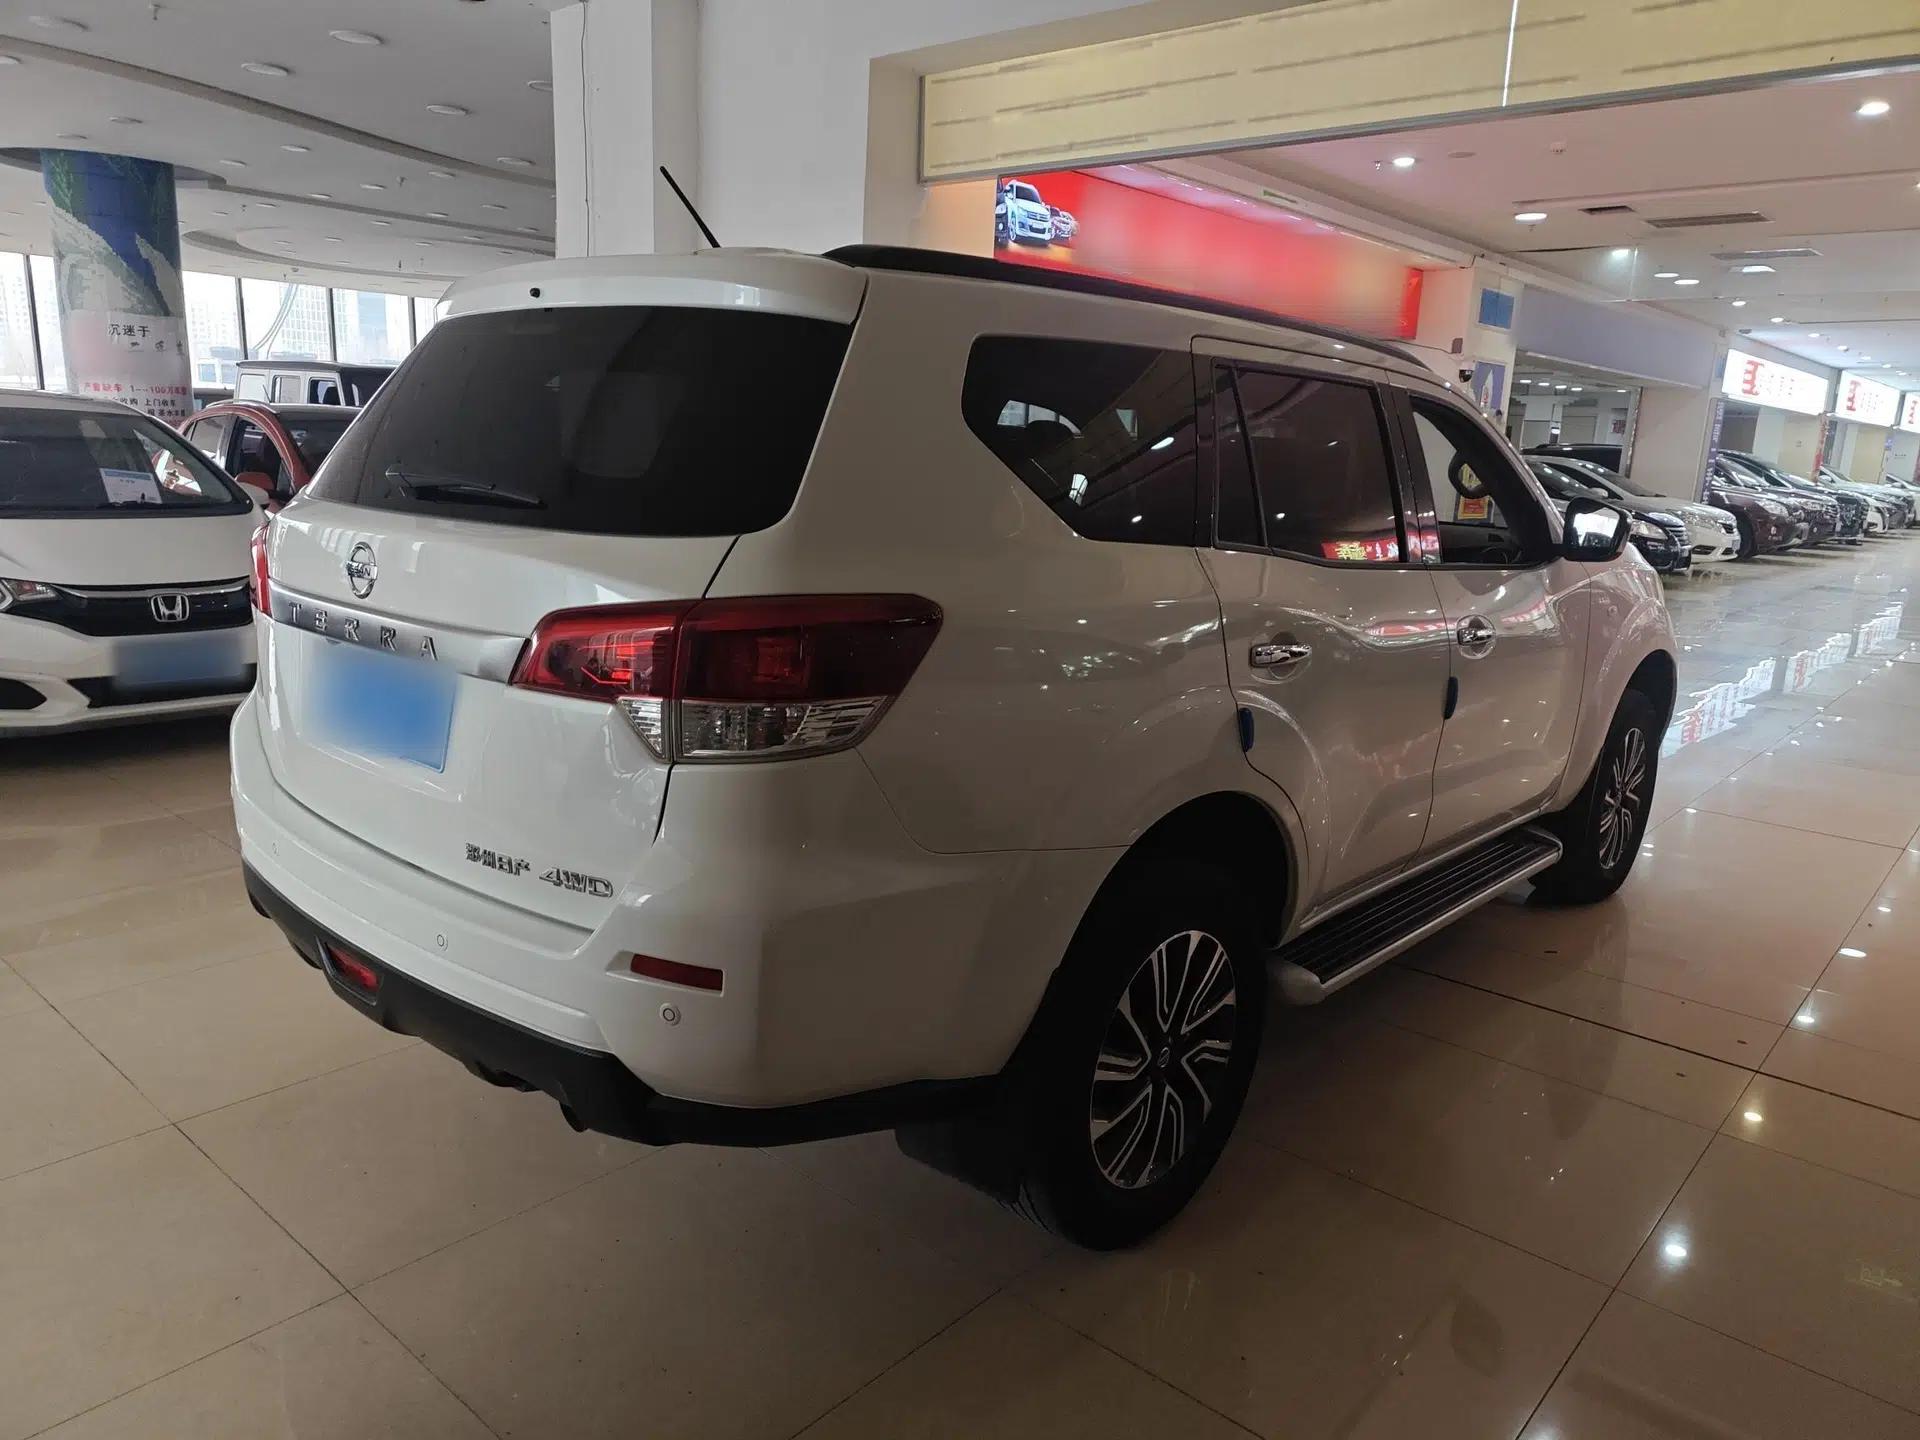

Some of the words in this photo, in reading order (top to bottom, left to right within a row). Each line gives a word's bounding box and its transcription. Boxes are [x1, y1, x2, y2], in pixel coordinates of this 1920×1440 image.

[109, 323, 150, 338] 沉迷于
[289, 602, 438, 661] TERRA
[539, 867, 614, 897] 4WD
